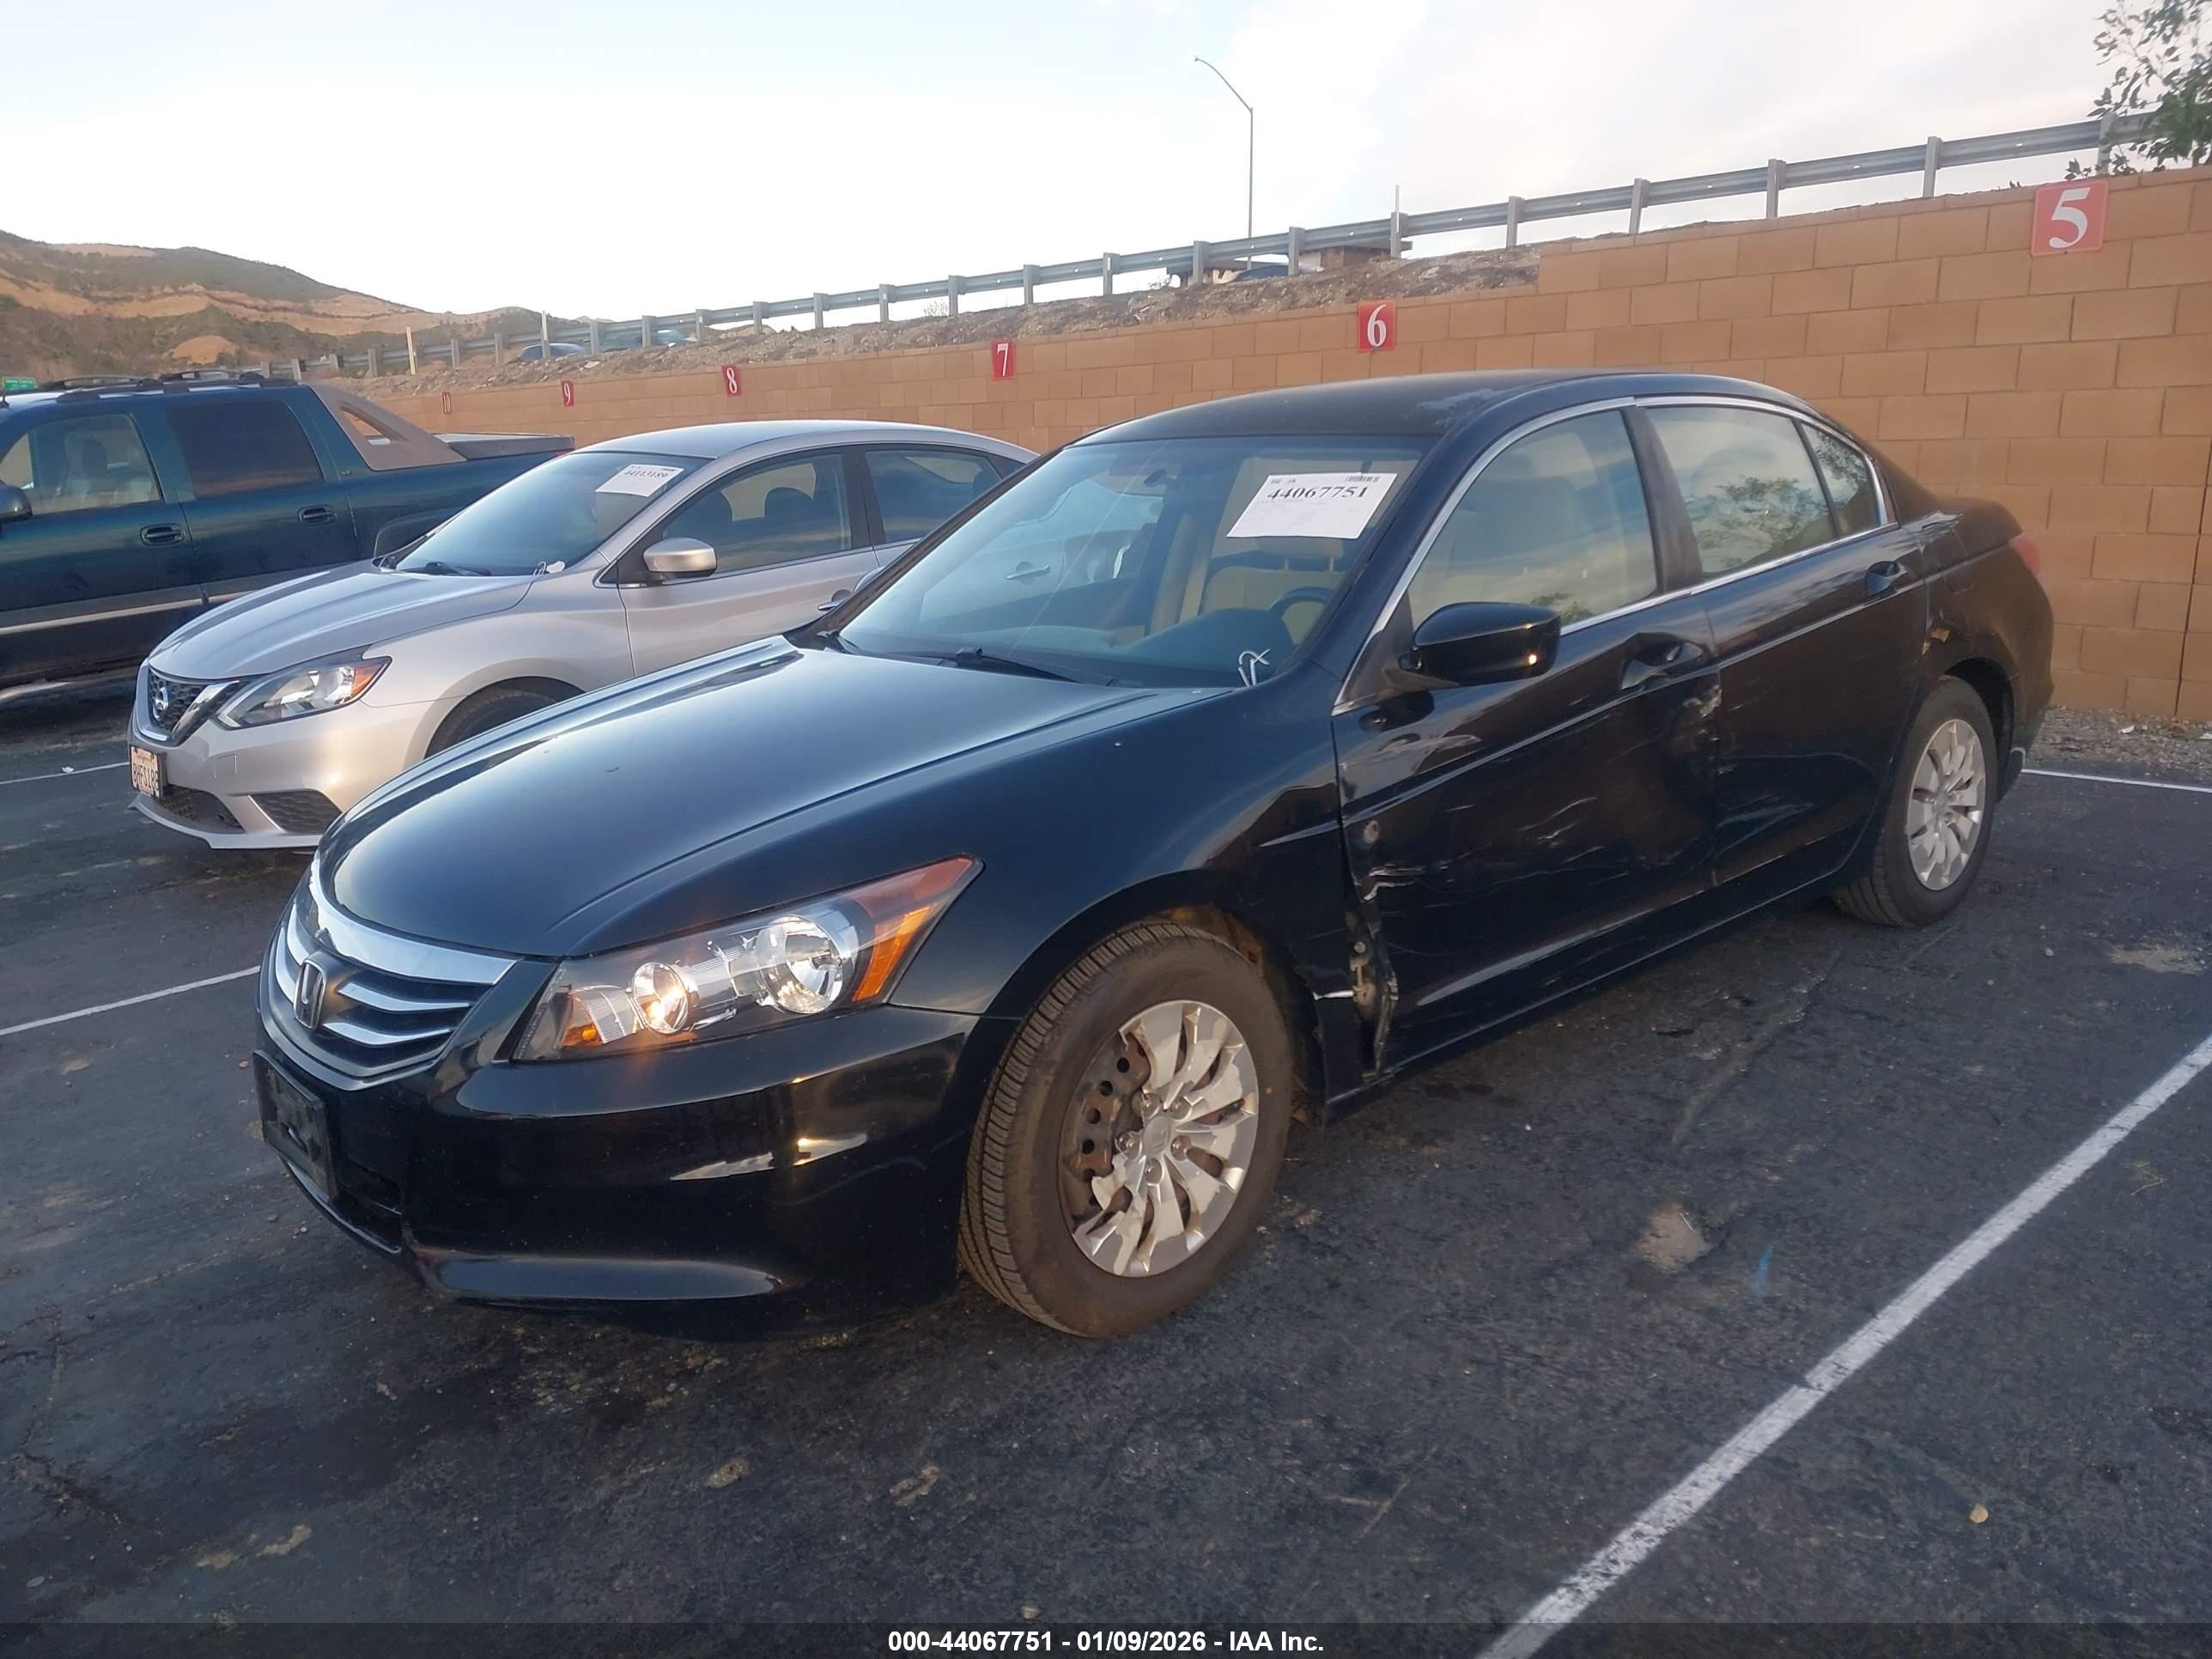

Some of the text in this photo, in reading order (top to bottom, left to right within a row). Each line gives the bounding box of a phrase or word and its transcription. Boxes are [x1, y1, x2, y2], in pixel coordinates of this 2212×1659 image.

[2049, 186, 2091, 249] 5
[1367, 303, 1388, 347] 6
[996, 343, 1009, 377] 7
[726, 368, 738, 393] 8
[443, 393, 451, 413] 10
[563, 383, 571, 405] 9
[1267, 486, 1369, 501] 44067751
